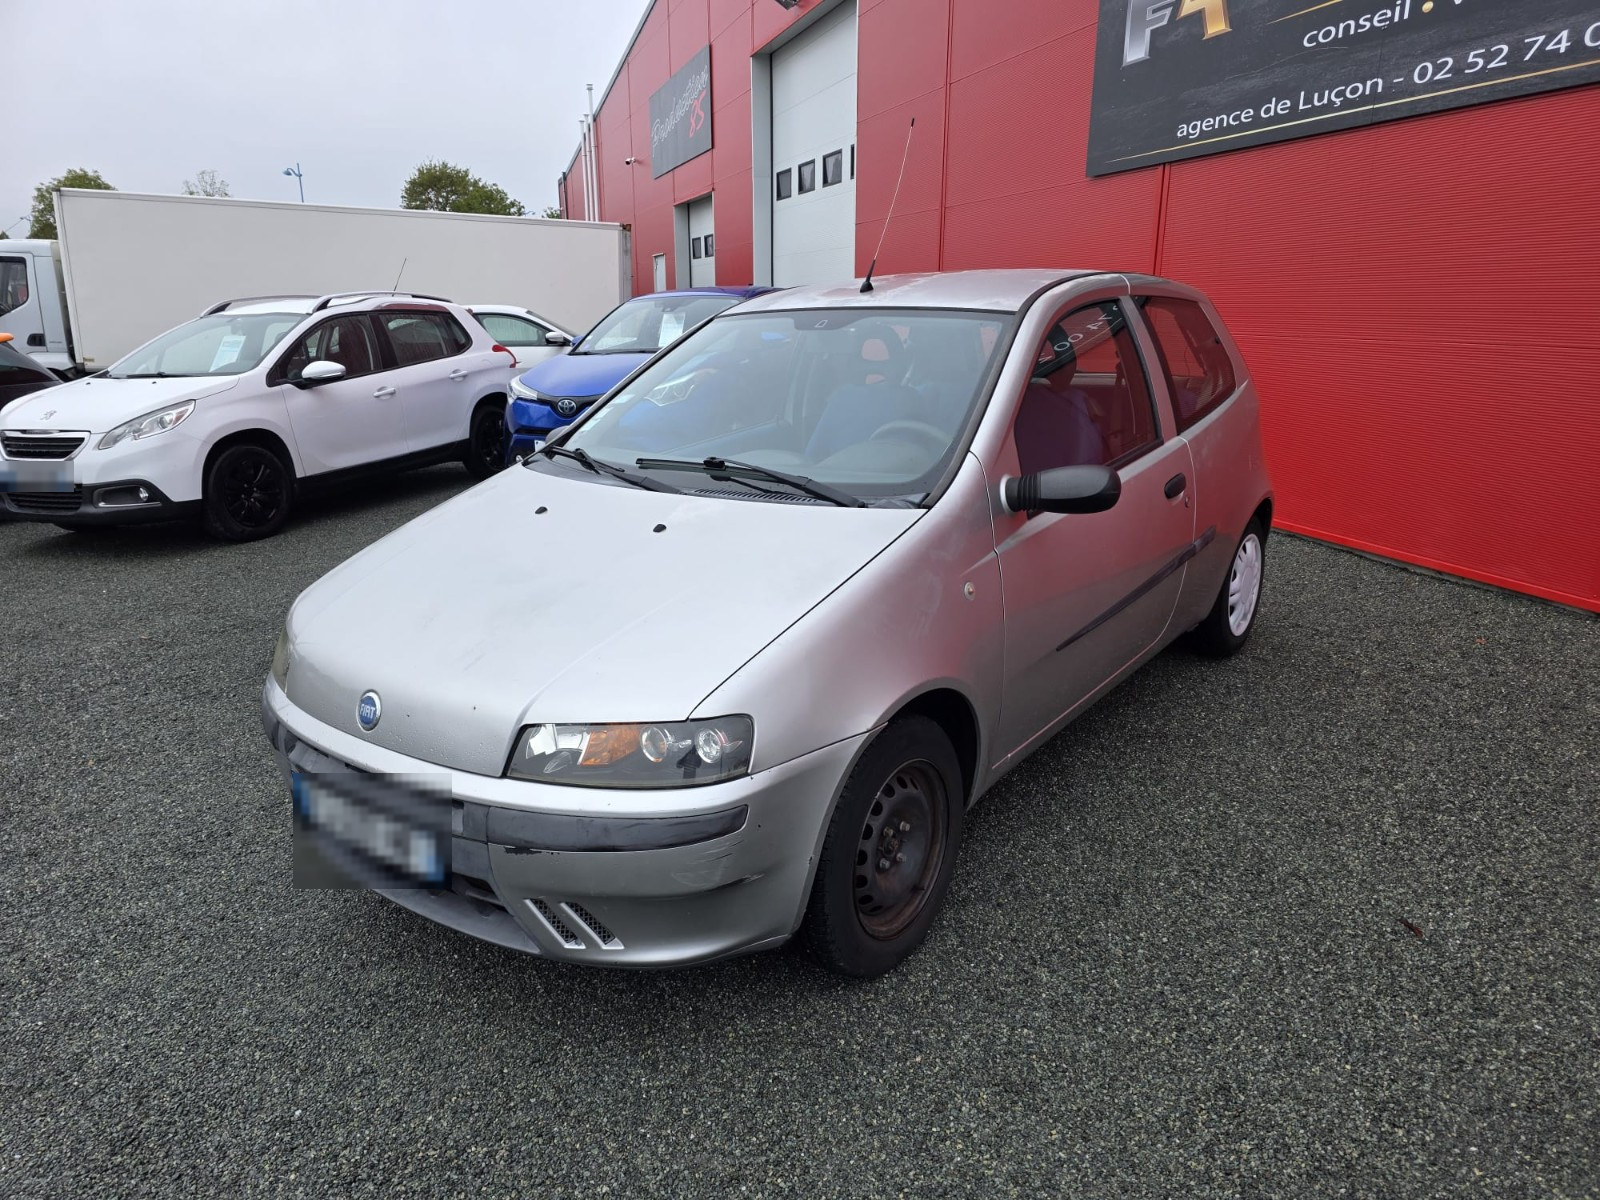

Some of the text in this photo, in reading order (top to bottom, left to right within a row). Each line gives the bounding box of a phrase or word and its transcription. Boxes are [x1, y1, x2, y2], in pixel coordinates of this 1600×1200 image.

[1303, 0, 1411, 47] conseil
[1176, 108, 1254, 139] agence
[1260, 97, 1291, 118] de
[1298, 77, 1383, 111] Luçon
[1413, 57, 1454, 84] 02
[1464, 44, 1509, 74] 52
[1523, 29, 1571, 61] 74
[360, 703, 376, 719] FIAT
